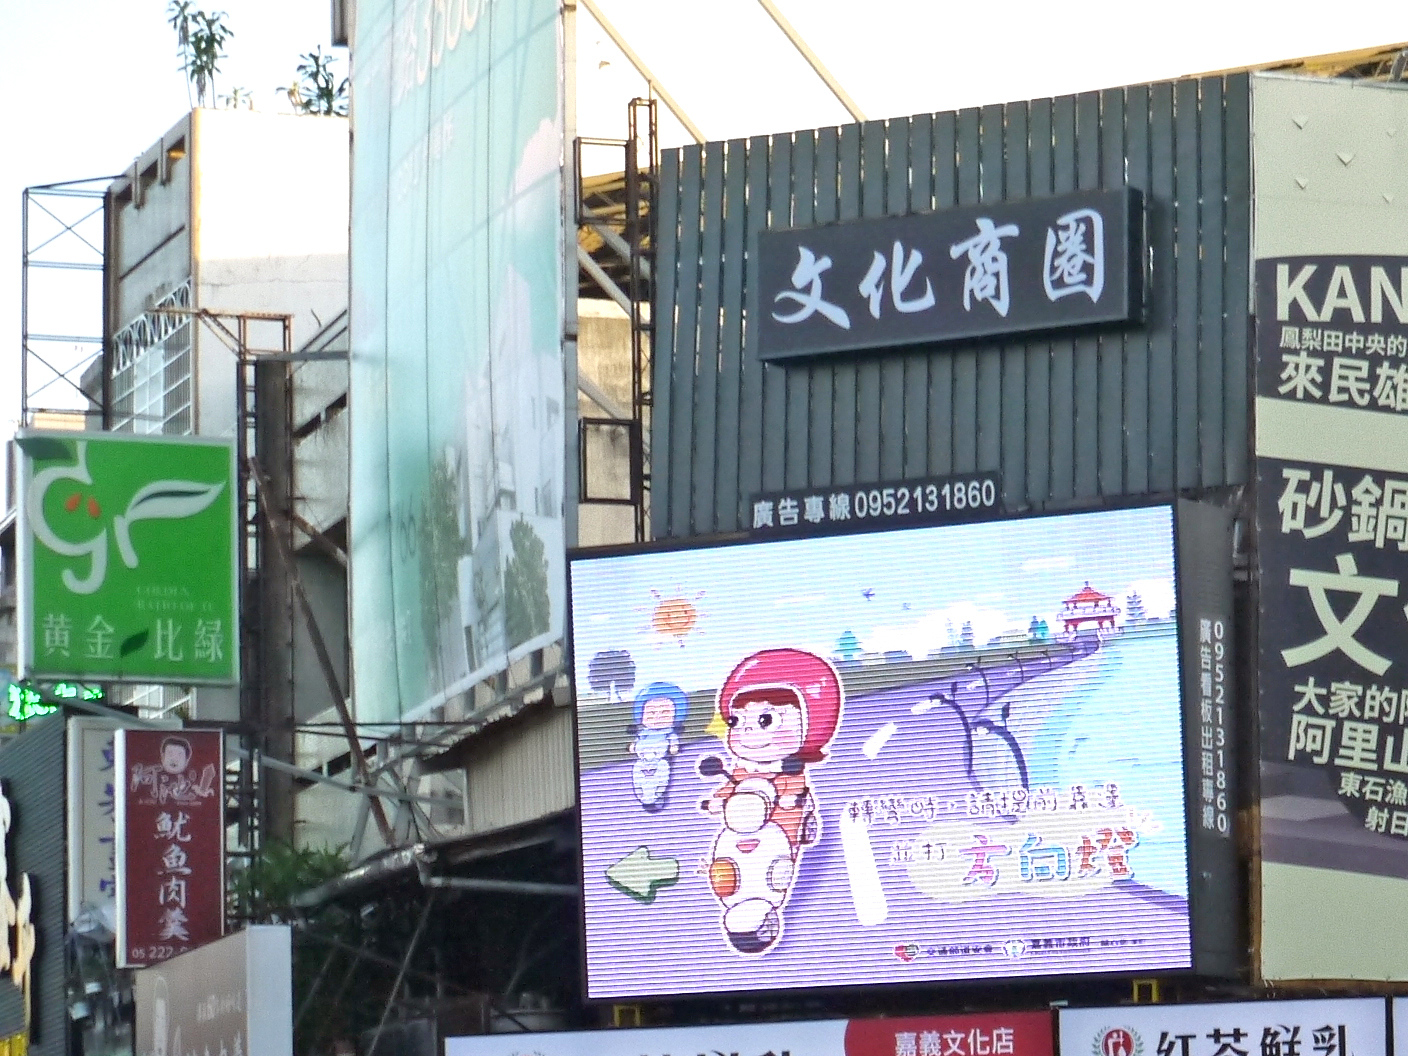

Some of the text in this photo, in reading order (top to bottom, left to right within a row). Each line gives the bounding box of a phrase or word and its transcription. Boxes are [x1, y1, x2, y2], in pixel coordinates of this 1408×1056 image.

[771, 207, 1104, 330] 文化商圈
[1214, 620, 1227, 833] 0952131860
[154, 811, 192, 941] 魷魚肉羹
